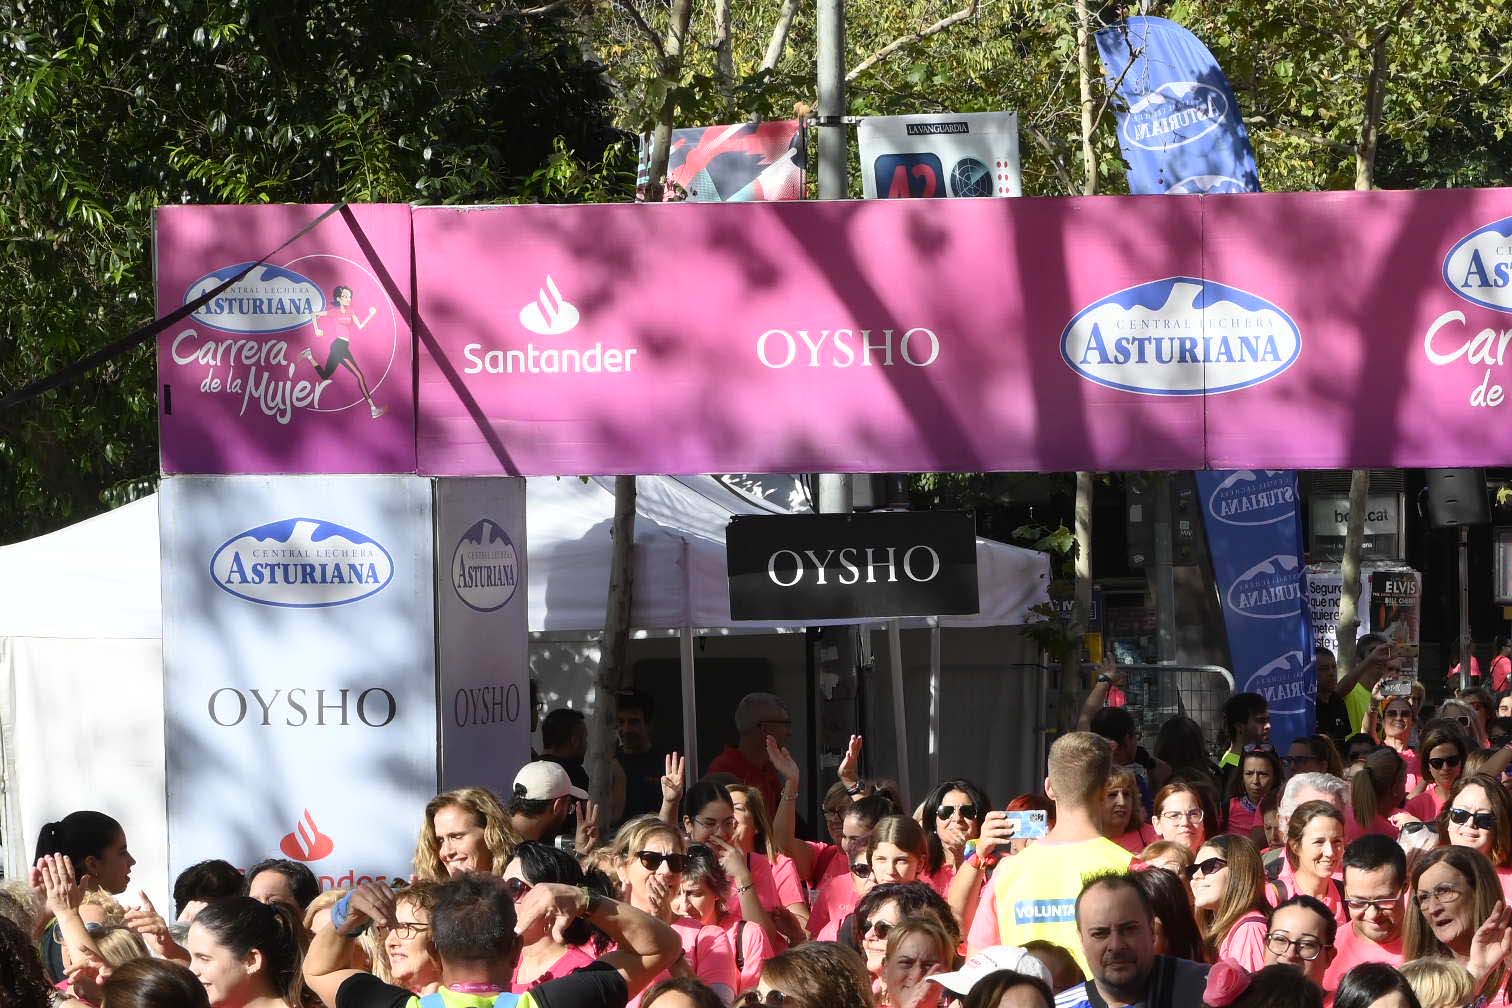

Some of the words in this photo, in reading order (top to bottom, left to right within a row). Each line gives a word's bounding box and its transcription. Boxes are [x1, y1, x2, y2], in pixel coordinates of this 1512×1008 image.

[1115, 317, 1192, 330] CENTRAL
[171, 328, 288, 366] Carrera
[463, 341, 637, 375] Santander
[756, 326, 940, 369] OYSHO
[1078, 321, 1283, 366] ASTURIANA
[200, 367, 222, 393] de
[226, 367, 243, 394] la
[239, 360, 333, 424] Mujer
[1470, 368, 1505, 408] de
[224, 550, 381, 586] ASTURIANA
[252, 548, 311, 559] CENTRAL
[316, 548, 374, 559] LECHERA
[456, 553, 515, 589] ASTURIANA
[768, 545, 940, 587] OYSHO
[1385, 581, 1416, 593] ELVIS
[1311, 609, 1343, 624] quiere
[207, 686, 397, 728] OYSHO
[454, 682, 521, 728] OYSHO
